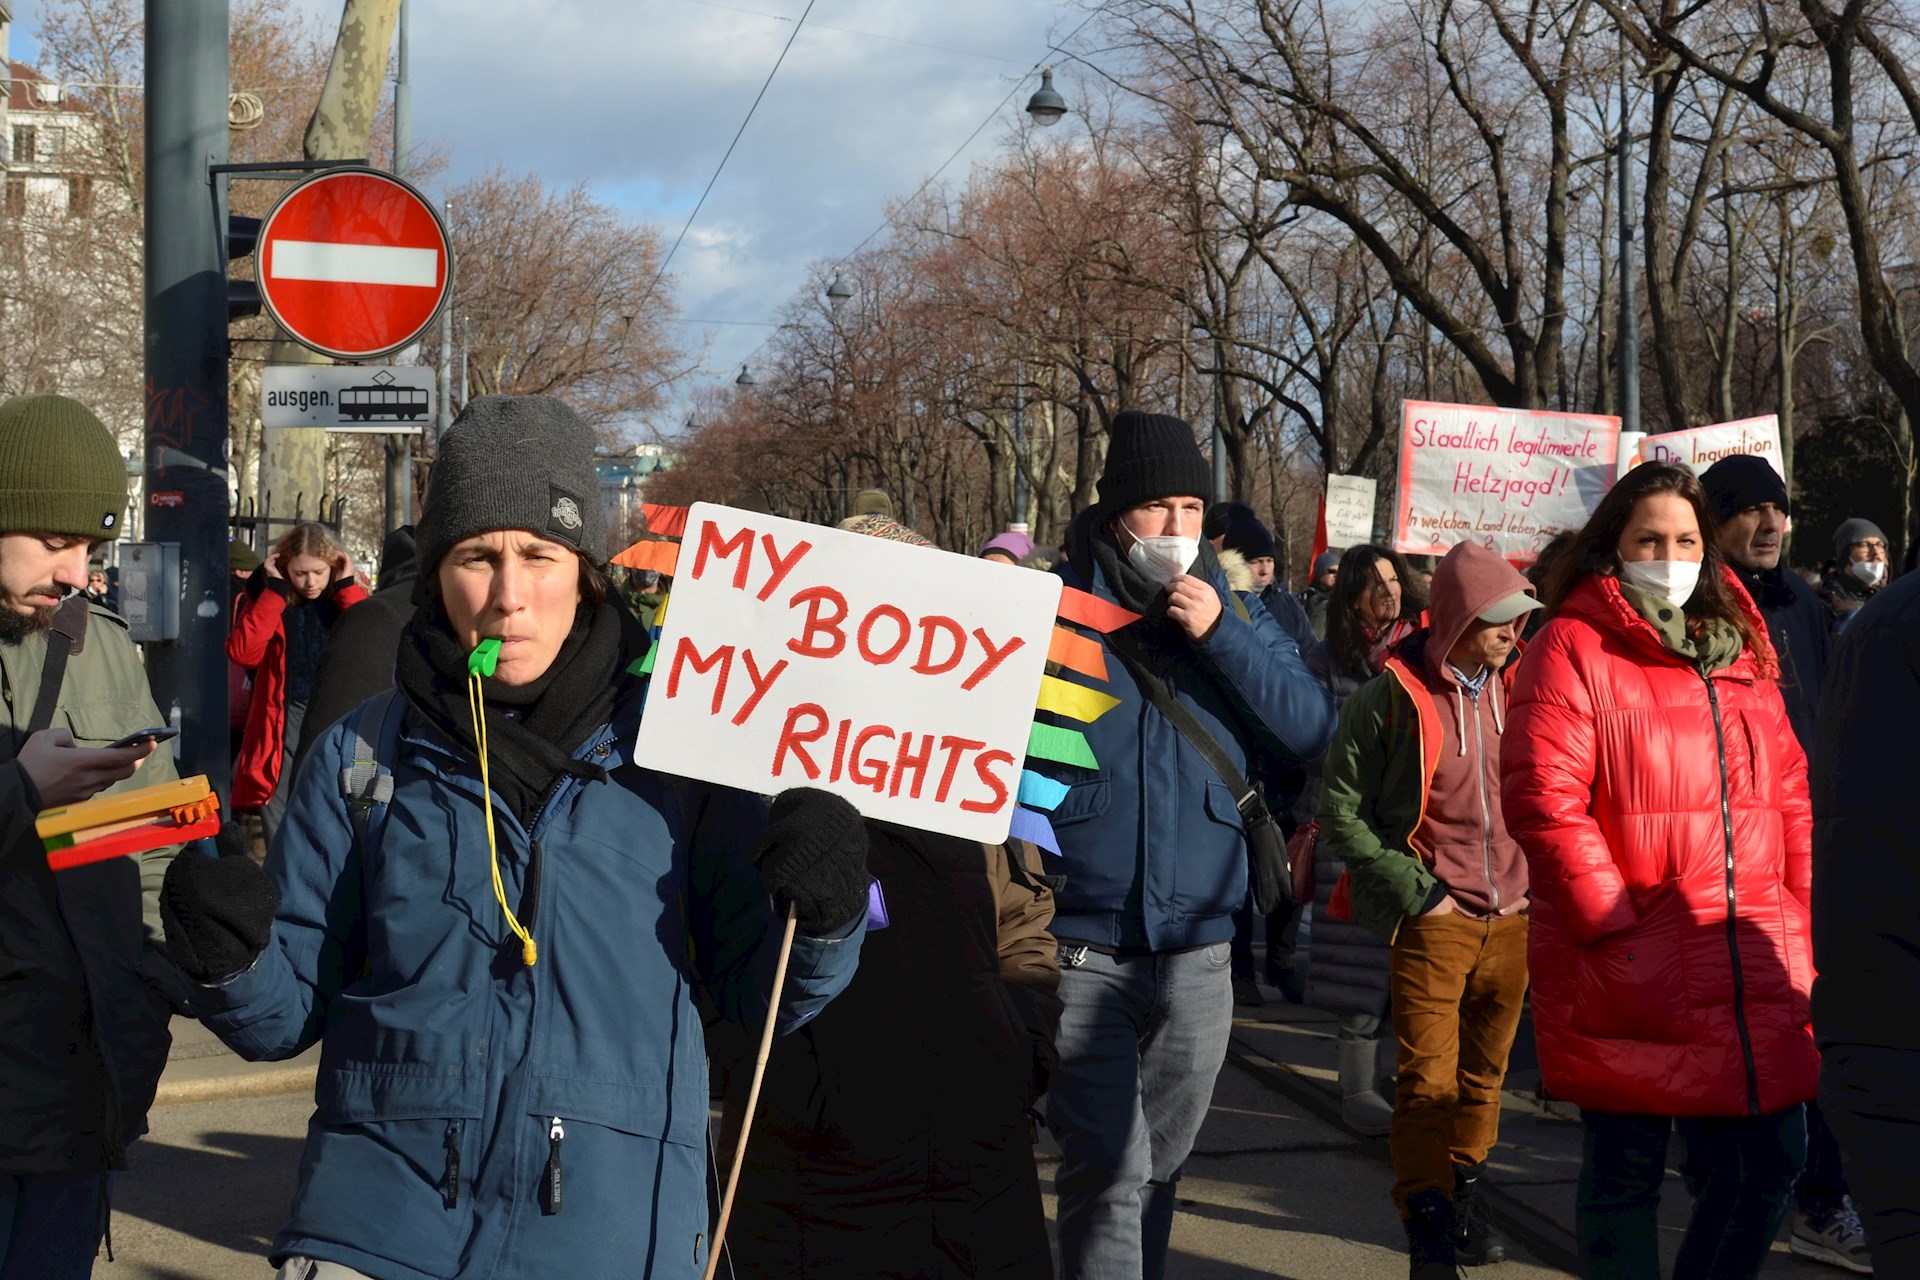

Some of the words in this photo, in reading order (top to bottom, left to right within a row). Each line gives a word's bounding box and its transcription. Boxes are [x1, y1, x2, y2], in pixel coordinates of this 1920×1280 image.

[268, 390, 334, 412] ausgen.
[1410, 419, 1499, 452] Staatlich
[1507, 424, 1597, 467] legitimierte
[1655, 445, 1682, 465] Die
[1692, 430, 1772, 464] Inquisition
[1453, 461, 1571, 507] Hetzjagd!
[1407, 508, 1418, 527] In
[1421, 510, 1472, 530] welchem
[1475, 509, 1507, 532] Land
[1507, 513, 1536, 534] leben
[692, 521, 812, 602] MY
[787, 586, 1026, 691] BODY
[666, 637, 789, 726] MY
[772, 703, 1015, 814] RIGHTS
